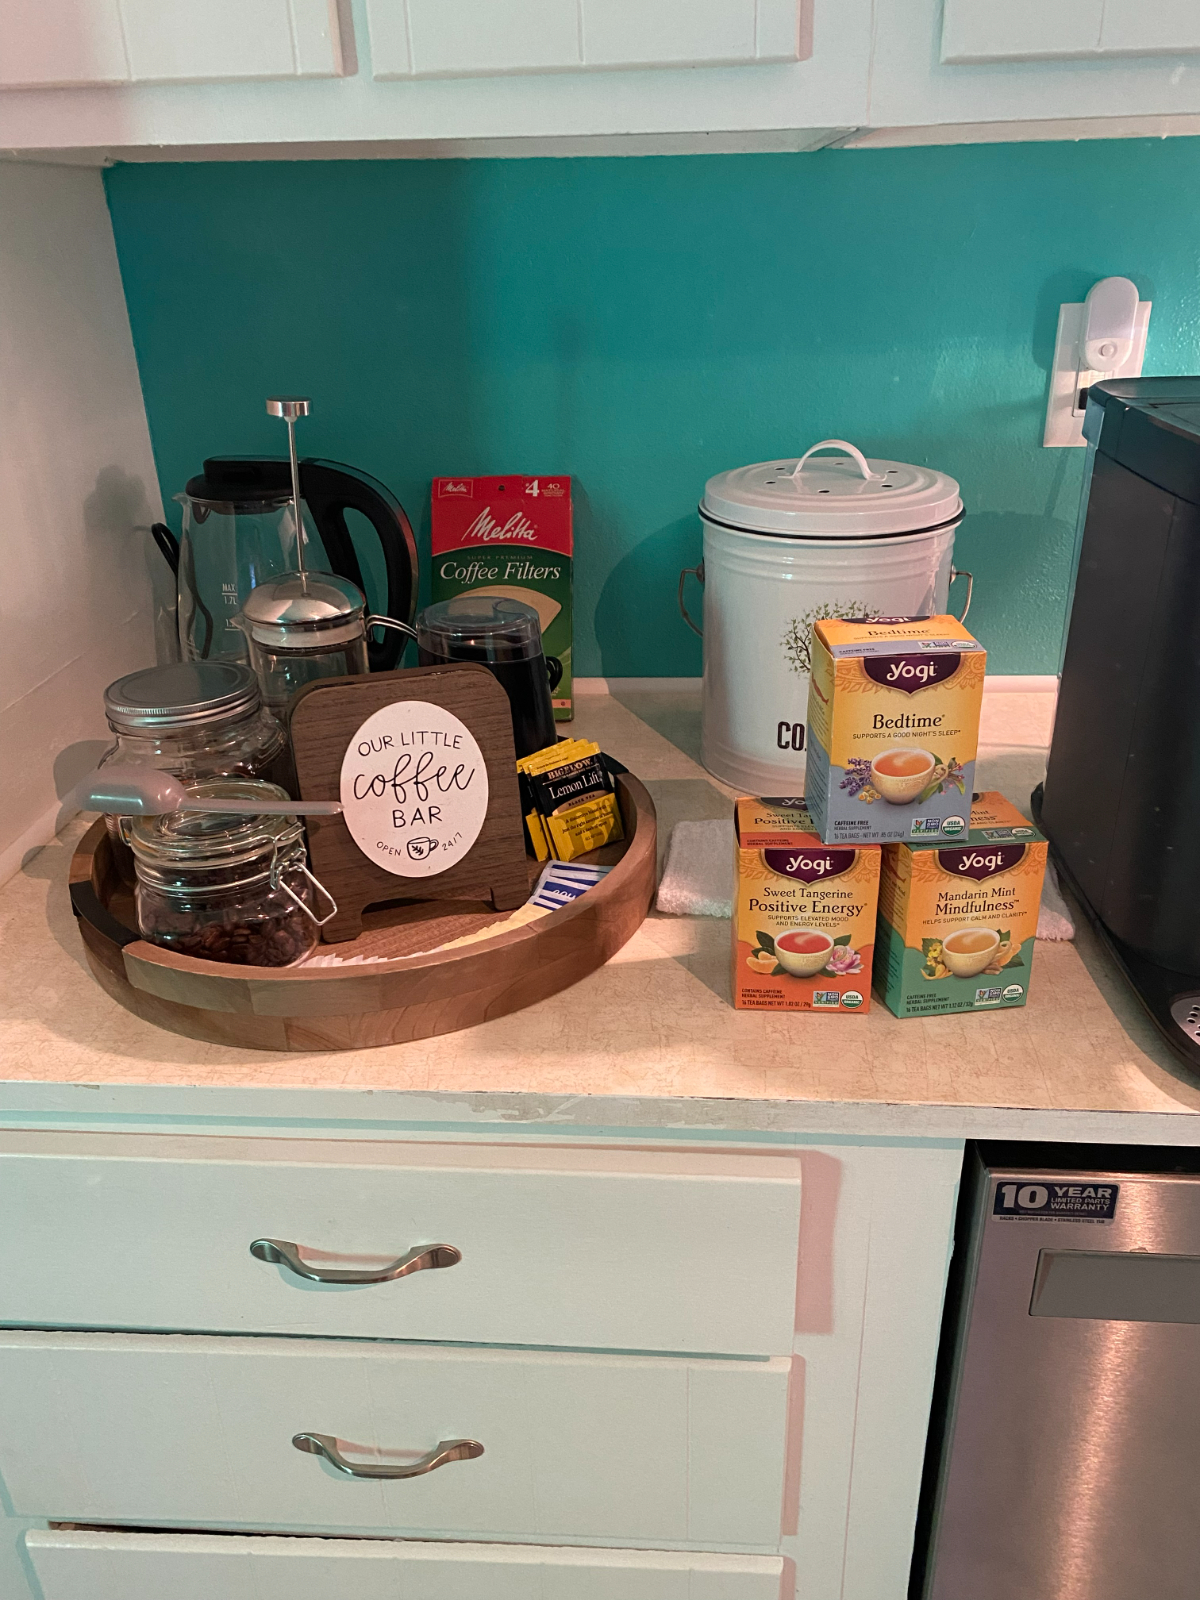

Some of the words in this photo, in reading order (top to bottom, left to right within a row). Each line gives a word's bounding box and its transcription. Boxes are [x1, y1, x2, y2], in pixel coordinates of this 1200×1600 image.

[461, 506, 538, 541] Melitta
[440, 561, 499, 584] Coffee
[503, 561, 561, 579] Filters
[886, 661, 937, 682] yogi
[873, 713, 942, 729] Bedtime
[358, 735, 395, 757] OUR
[401, 730, 464, 750] LITTLE
[777, 721, 807, 751] CO
[852, 732, 886, 740] SUPPORTS
[911, 730, 937, 738] NIGHT'S
[353, 751, 476, 804] coffee
[549, 780, 583, 799] Lemon
[781, 798, 806, 806] yo
[392, 805, 443, 828] BAR
[754, 817, 806, 825] Positive
[376, 841, 402, 856] OPEN
[441, 831, 463, 851] 24/7
[785, 855, 833, 875] yogi
[958, 852, 1004, 871] yogi
[763, 887, 796, 898] Sweet
[799, 887, 854, 900] Tangerine
[938, 890, 988, 902] Mandarin
[991, 887, 1016, 898] Mint
[749, 898, 807, 913] Positive
[812, 900, 864, 917] Energy
[943, 916, 969, 924] SUPPORT
[970, 914, 988, 922] CALM
[1001, 1184, 1049, 1209] 10
[1054, 1186, 1113, 1198] YEAR
[1050, 1202, 1110, 1211] WARRANTY
